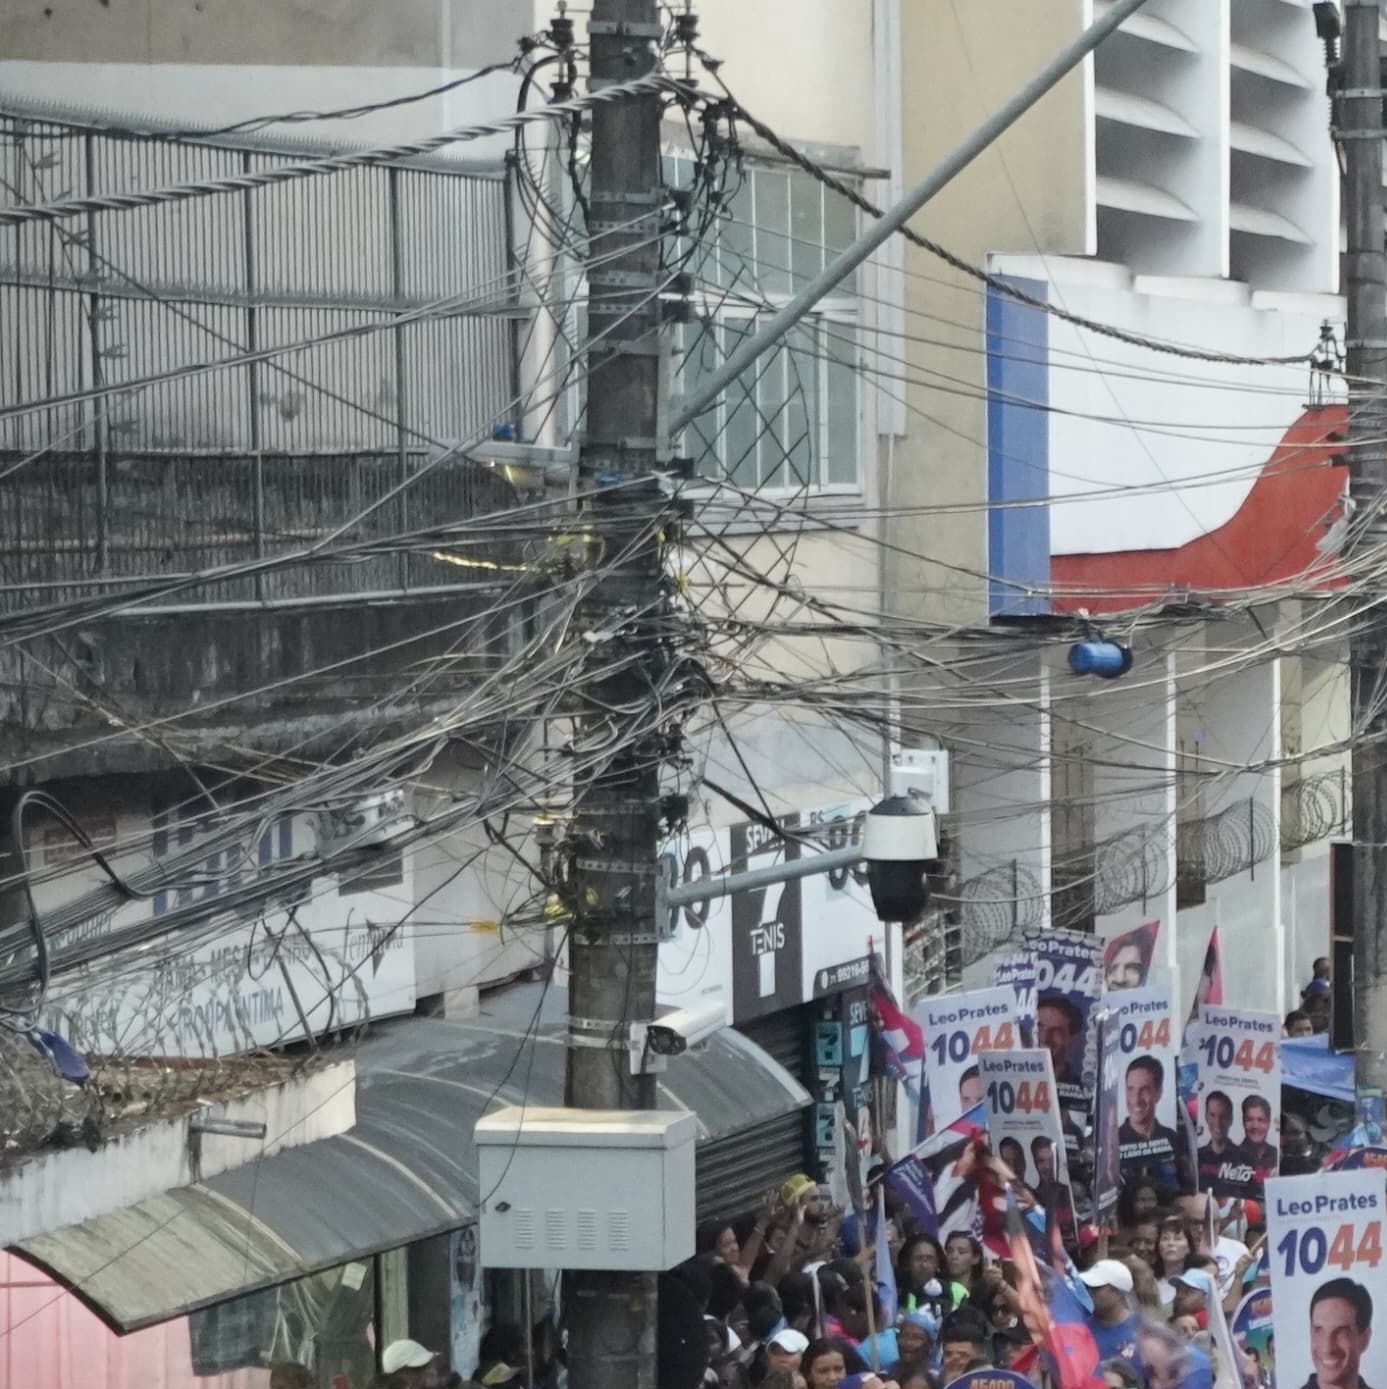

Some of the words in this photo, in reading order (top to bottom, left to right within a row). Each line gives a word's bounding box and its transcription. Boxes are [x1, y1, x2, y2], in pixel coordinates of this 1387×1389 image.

[750, 924, 785, 955] TENIS
[930, 1020, 1015, 1066] 1044
[1206, 1033, 1278, 1074] 1044
[986, 1080, 1051, 1115] 1044
[1277, 1220, 1383, 1277] 1044
